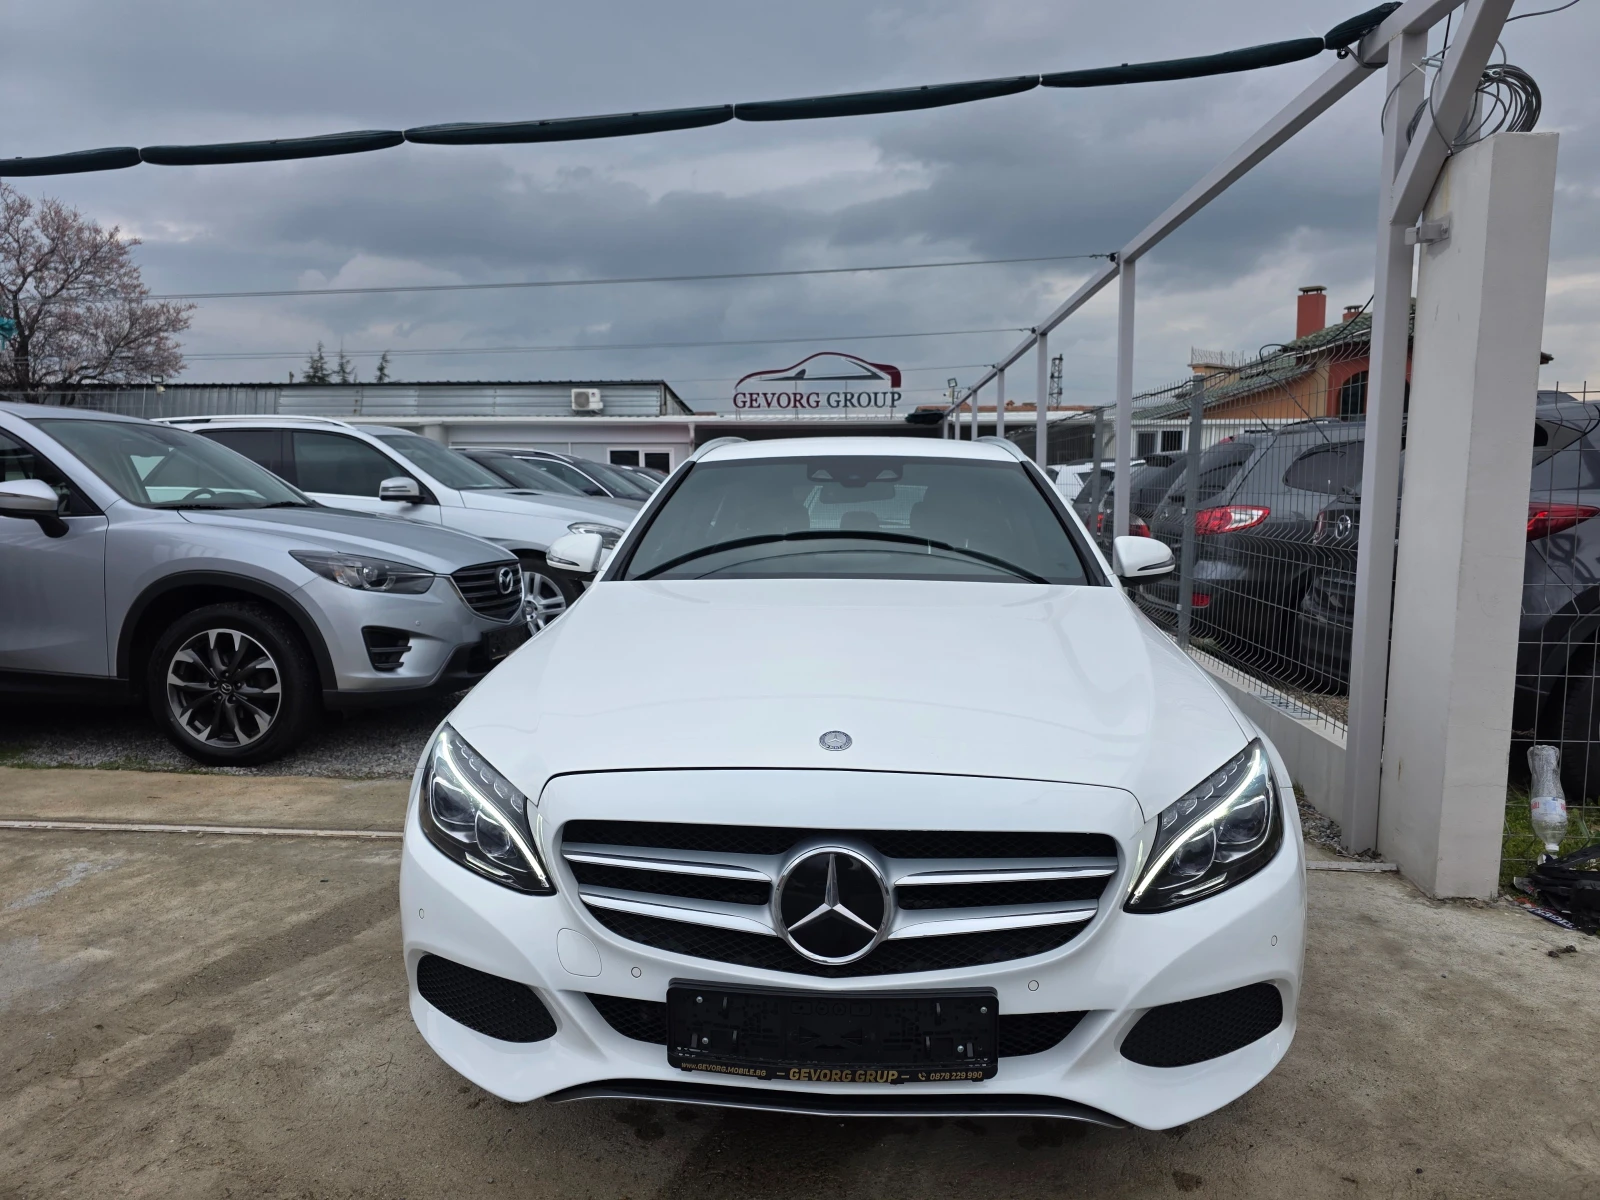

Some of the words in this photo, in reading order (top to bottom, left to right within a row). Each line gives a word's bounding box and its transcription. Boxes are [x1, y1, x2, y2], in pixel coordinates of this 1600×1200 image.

[733, 392, 820, 409] GEVORG
[826, 391, 902, 408] GROUP
[789, 1068, 852, 1082] GEVORG
[855, 1070, 898, 1083] GRUP
[930, 1072, 950, 1080] 0878
[951, 1072, 966, 1080] 229
[967, 1071, 983, 1079] 990
